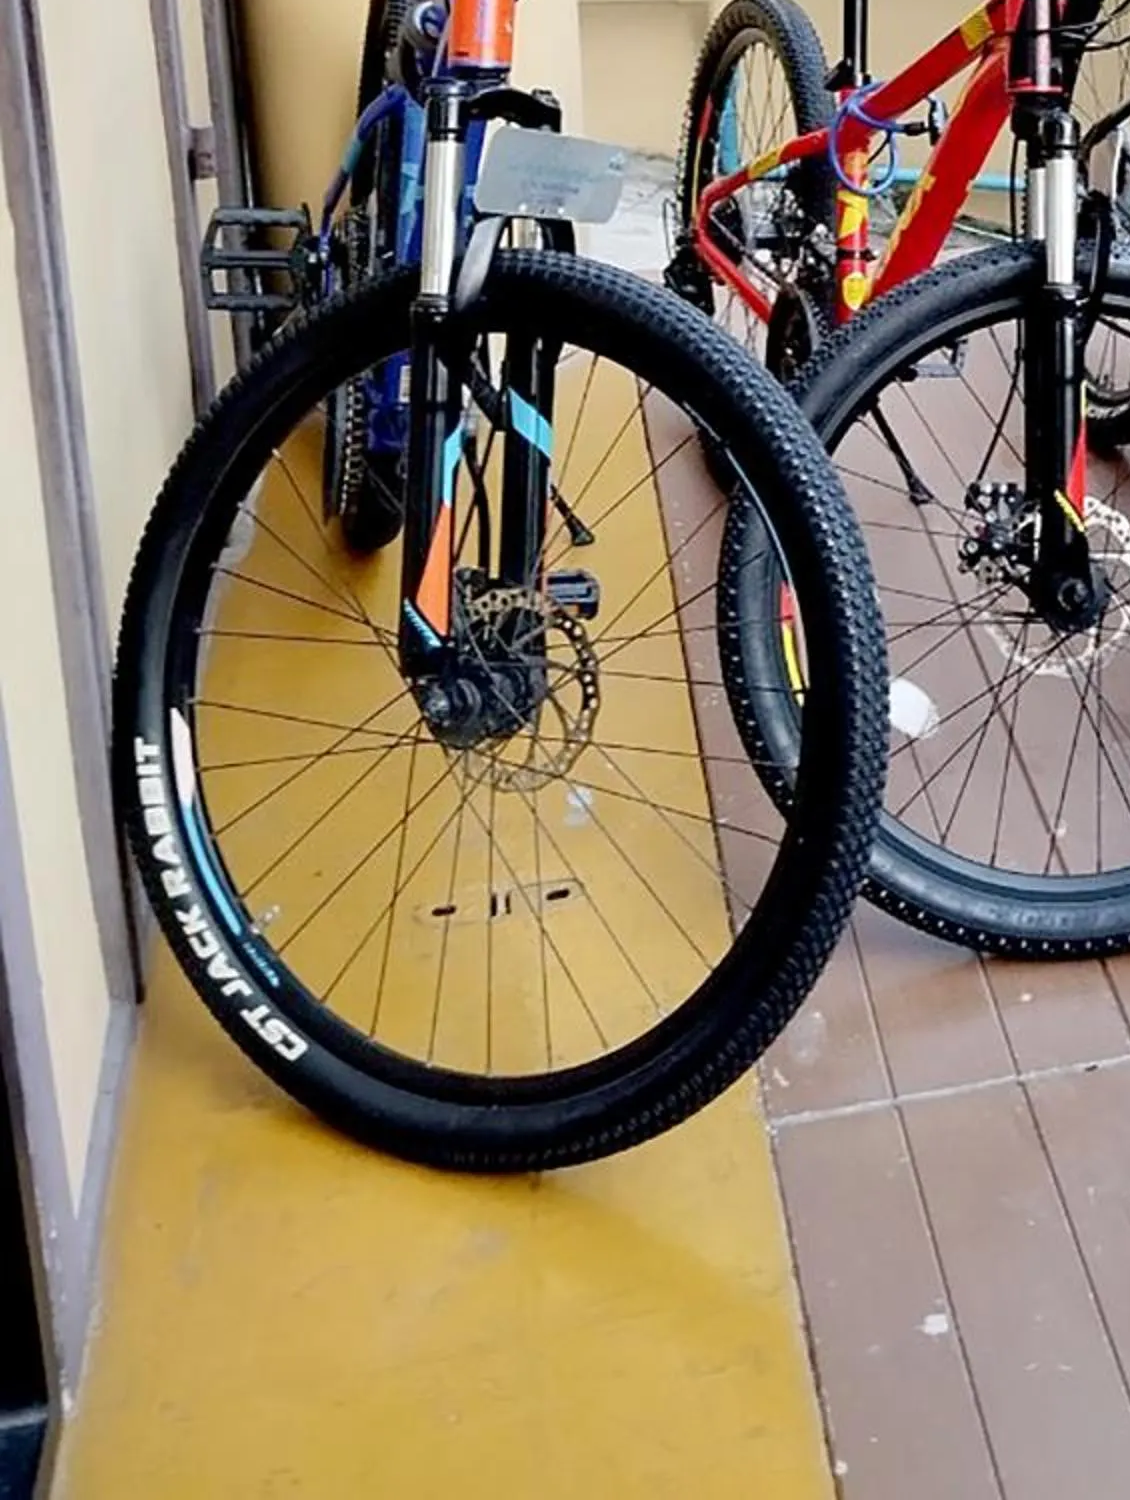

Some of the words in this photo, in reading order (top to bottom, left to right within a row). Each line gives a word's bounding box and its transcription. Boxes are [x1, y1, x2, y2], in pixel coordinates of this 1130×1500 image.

[134, 736, 192, 899] RABBIT
[175, 904, 253, 998] JACK
[240, 1003, 308, 1062] CST
